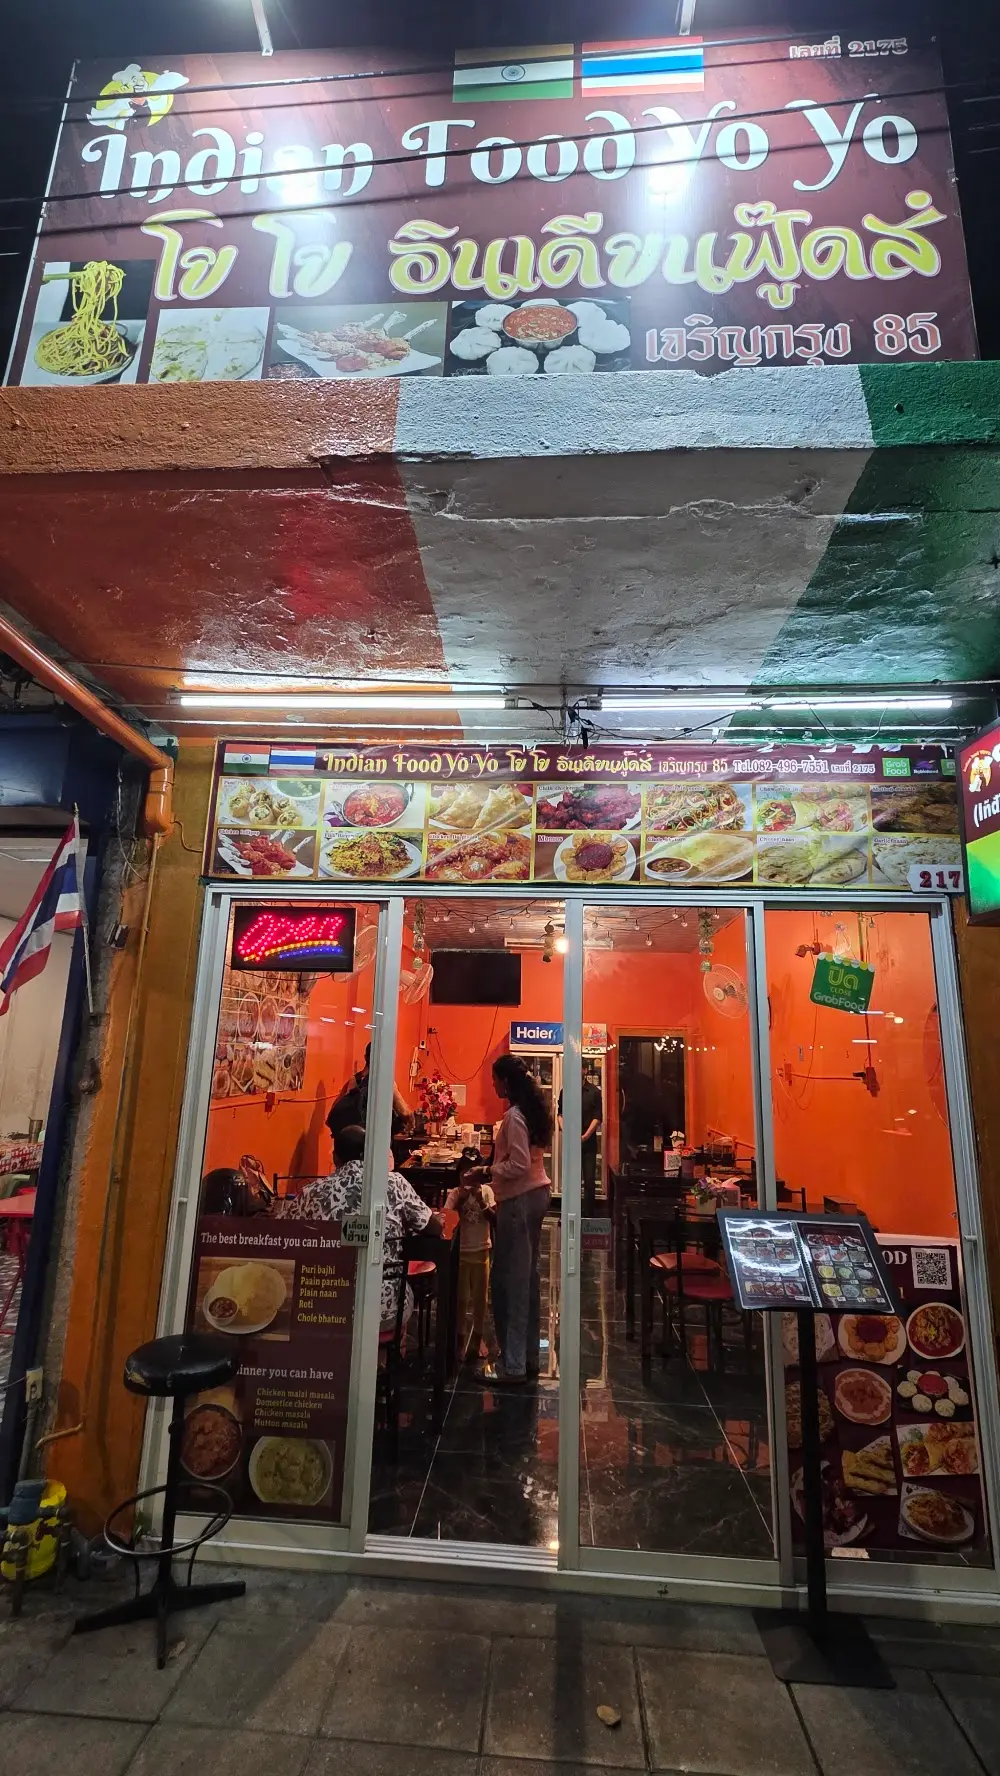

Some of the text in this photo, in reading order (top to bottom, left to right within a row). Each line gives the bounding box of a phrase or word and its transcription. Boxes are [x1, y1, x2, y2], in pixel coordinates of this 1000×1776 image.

[848, 38, 908, 57] 2175
[81, 93, 918, 204] Indian Food Yo Yo
[873, 312, 942, 356] 85
[322, 752, 388, 774] Indian
[392, 753, 442, 773] Food
[442, 752, 469, 778] Yo
[472, 752, 499, 778] Yo
[712, 758, 728, 773] 85
[885, 760, 907, 768] Grab
[919, 870, 961, 890] 217
[830, 987, 852, 997] CLOSE
[813, 991, 866, 1012] GrabFood
[516, 1026, 554, 1039] Haier
[201, 1232, 341, 1250] The best breakfast you can have
[301, 1265, 316, 1274] Puri
[321, 1277, 350, 1288] paratha
[299, 1288, 337, 1298] Plain naan
[299, 1300, 313, 1309] Roti
[297, 1313, 346, 1324] Chole bhature
[236, 1364, 334, 1380] inner you can have
[257, 1388, 286, 1398] Chicken
